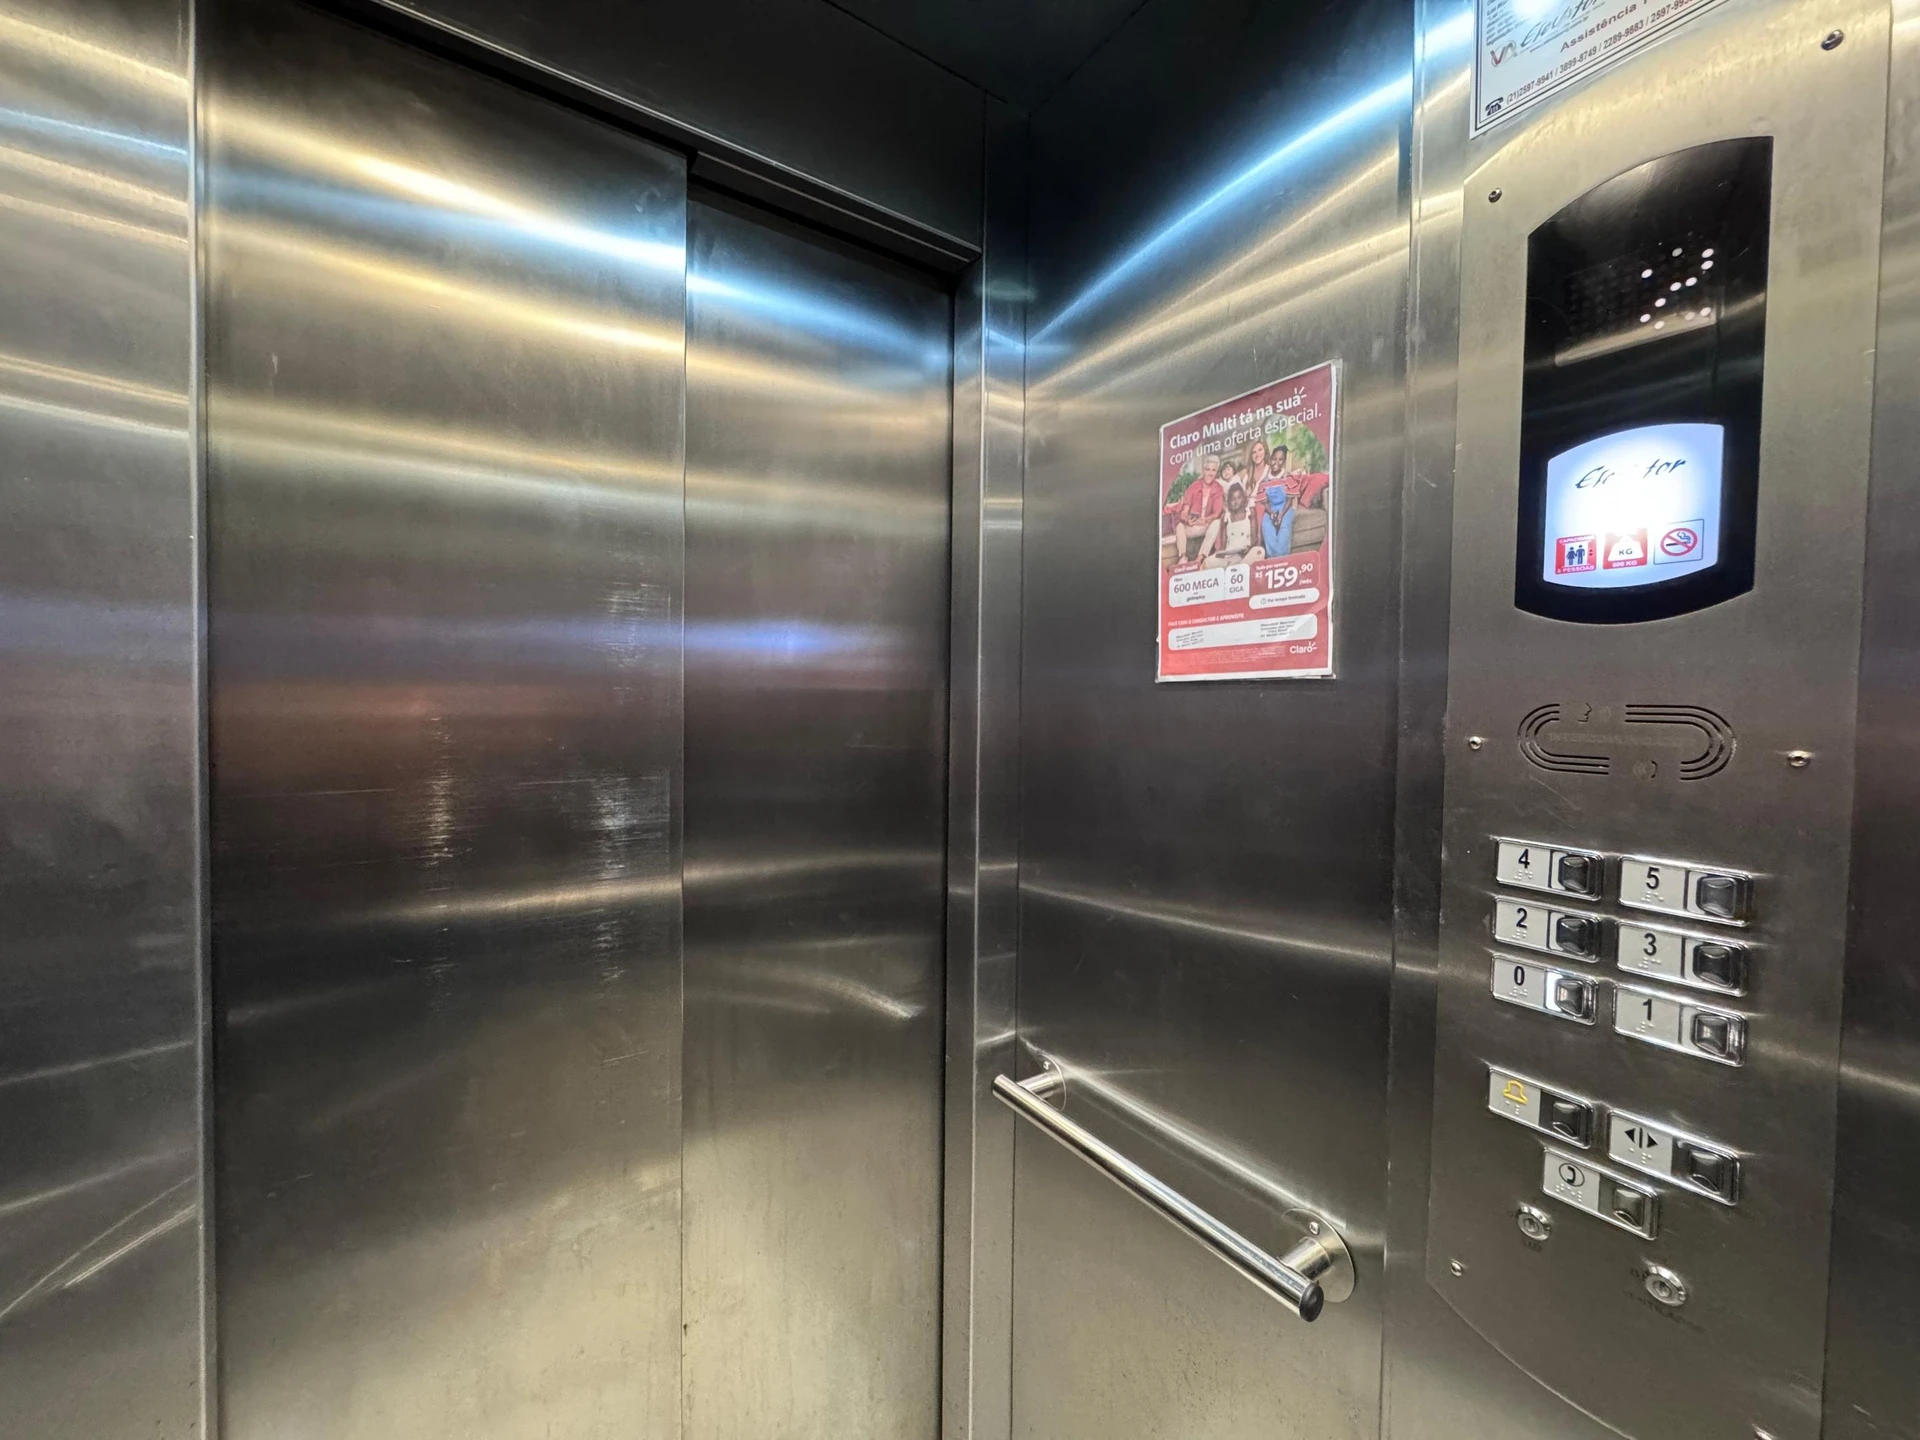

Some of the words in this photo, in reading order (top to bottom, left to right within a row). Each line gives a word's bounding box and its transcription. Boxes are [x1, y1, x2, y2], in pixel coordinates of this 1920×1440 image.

[1560, 3, 1637, 53] Assistência
[1506, 70, 1554, 105] (21)2597-9941
[1559, 45, 1598, 74] 3899-8749
[1603, 19, 1645, 50] 2289-9883
[1169, 431, 1200, 450] Claro
[1202, 413, 1237, 440] Multi
[1239, 408, 1253, 426] tá
[1256, 405, 1274, 421] na
[1169, 449, 1194, 466] com
[1196, 440, 1222, 457] uma
[1223, 425, 1262, 448] oferta
[1264, 402, 1322, 435] especial.
[1618, 547, 1633, 556] KG
[1230, 573, 1243, 585] 60
[1265, 566, 1298, 590] 159
[1563, 565, 1595, 573] PESSOAS
[1174, 582, 1191, 594] 600
[1192, 577, 1219, 591] MEGA
[1229, 586, 1244, 594] GIGA
[1290, 644, 1313, 655] Claro
[1517, 848, 1530, 869] 4
[1646, 867, 1660, 890] 5
[1516, 908, 1528, 928] 2
[1643, 933, 1657, 956] 3
[1514, 966, 1525, 986] 0
[1643, 998, 1654, 1021] 1
